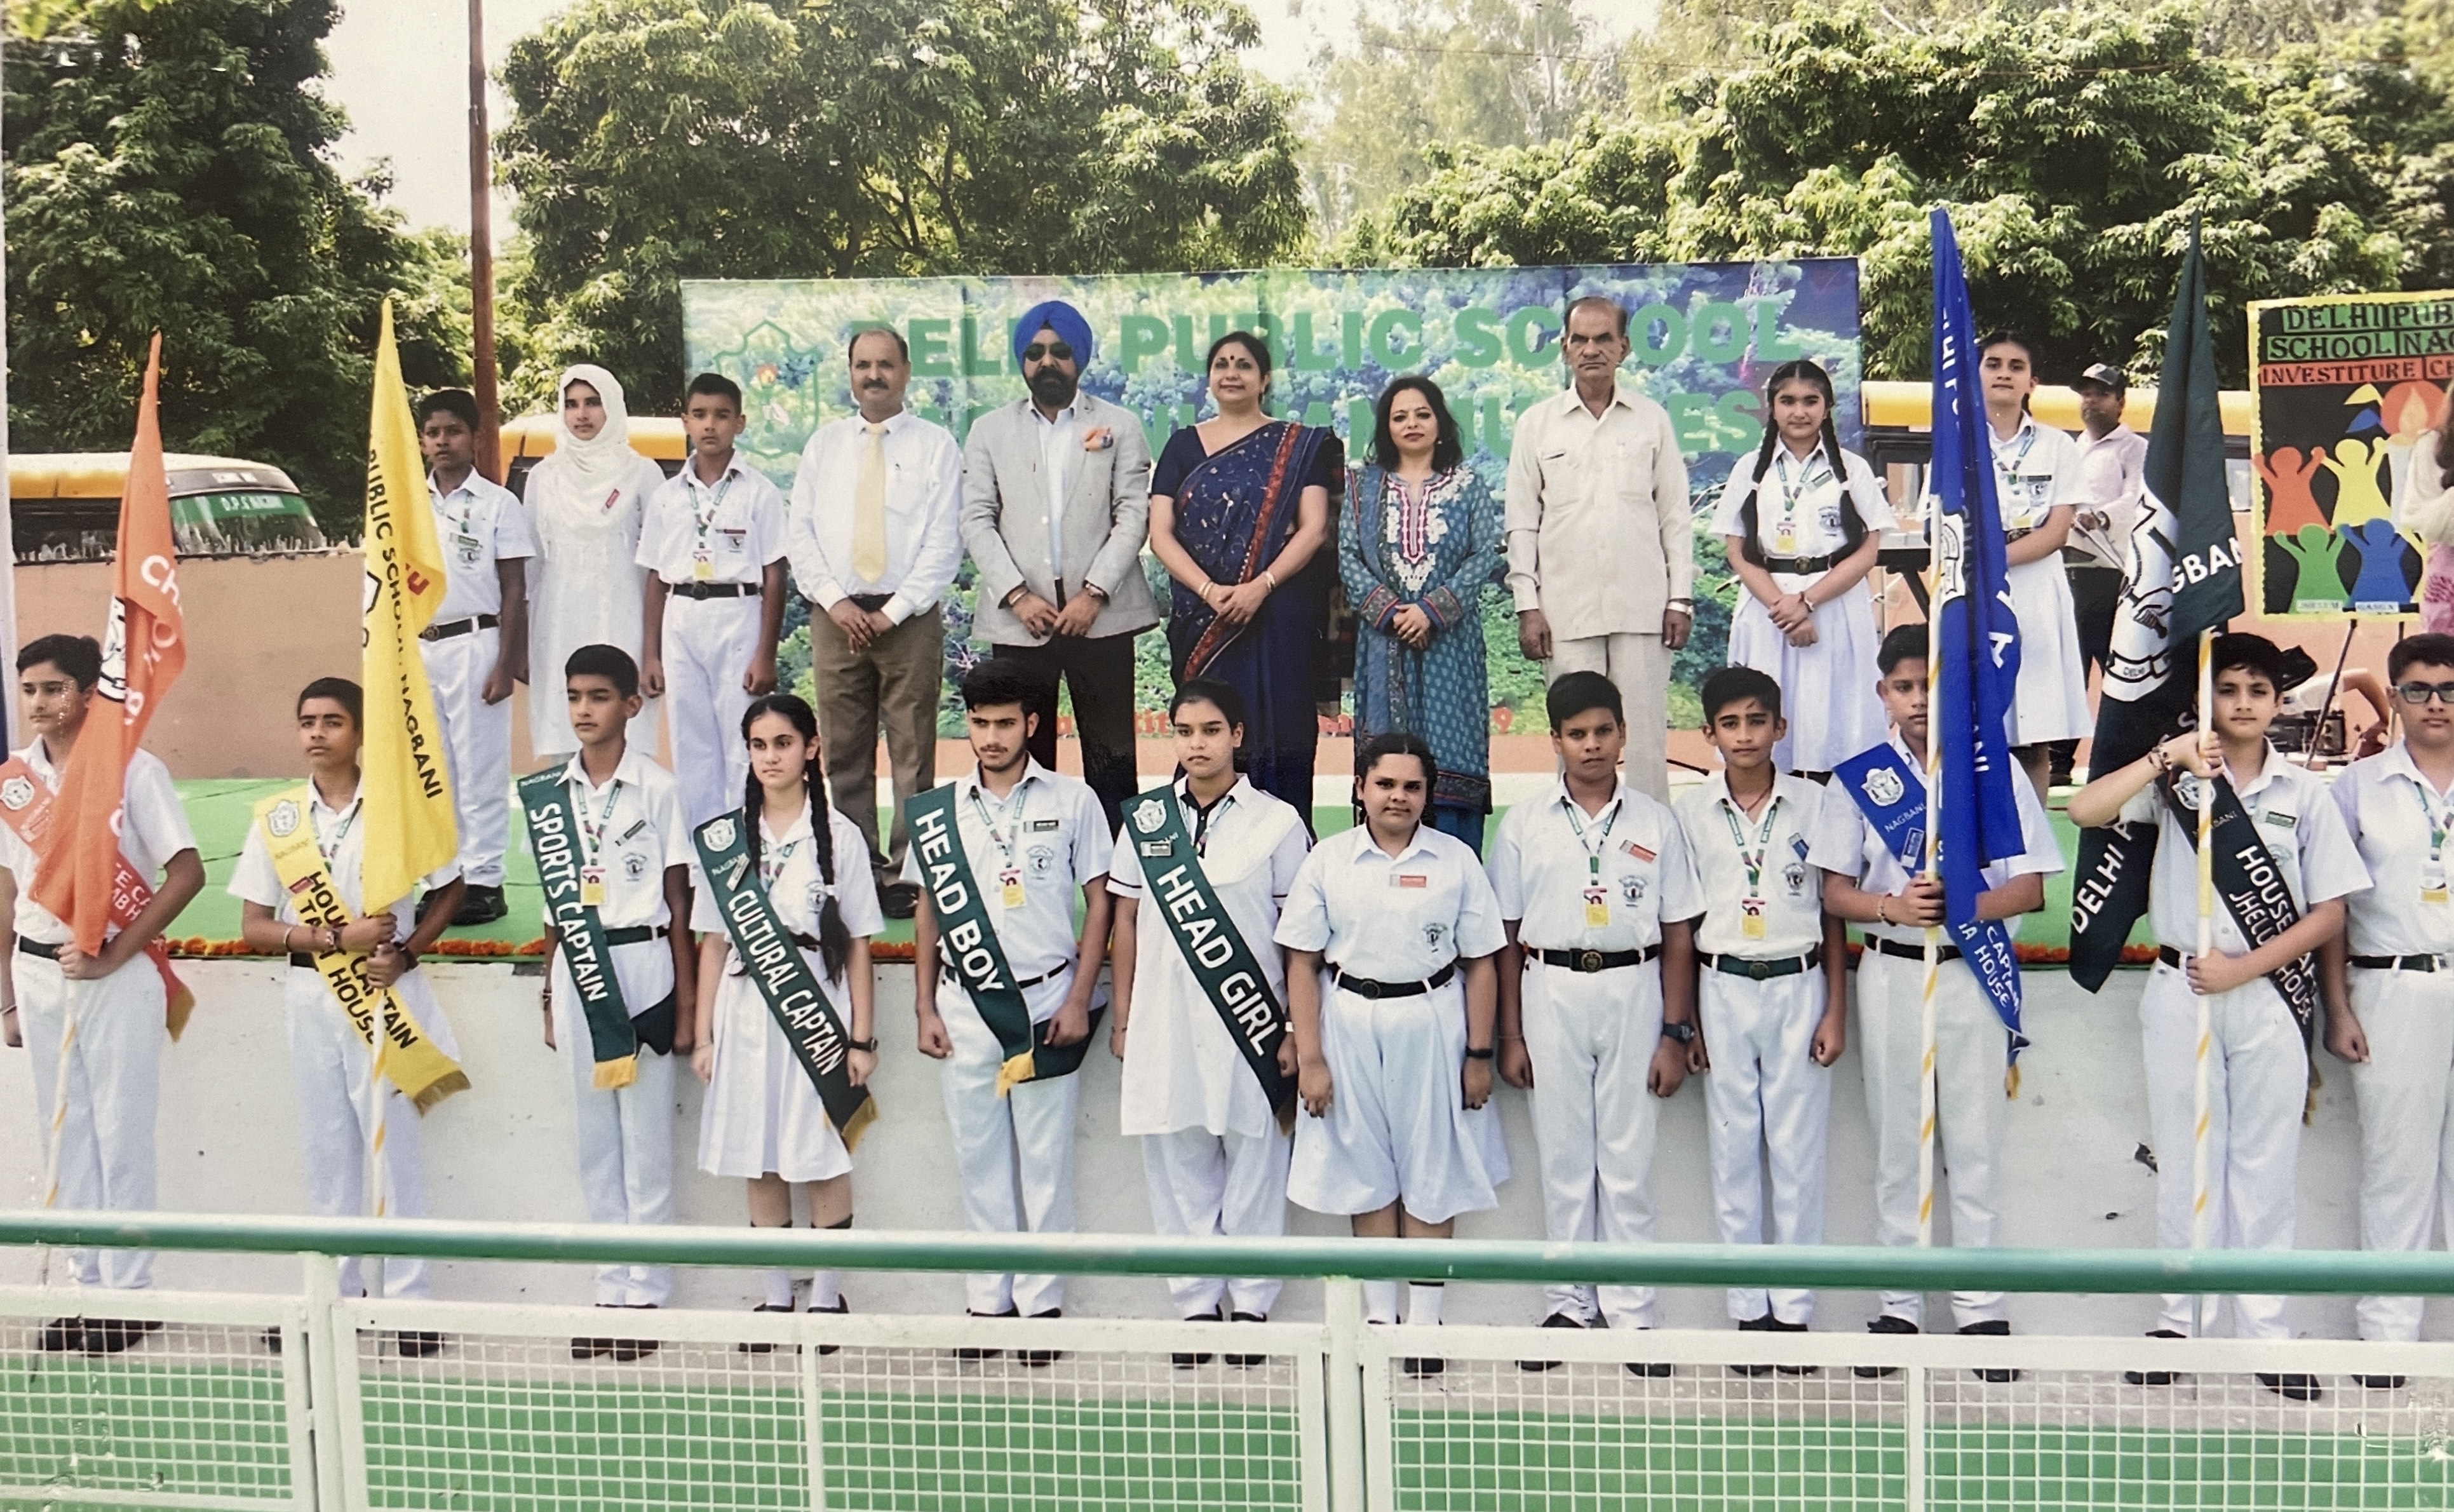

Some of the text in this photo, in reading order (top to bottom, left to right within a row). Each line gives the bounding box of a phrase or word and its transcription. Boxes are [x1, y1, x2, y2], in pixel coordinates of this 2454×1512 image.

[1453, 300, 1804, 369] SCOOL
[2269, 332, 2392, 360] SCHOOL
[2286, 304, 2382, 330] DELHI
[2262, 360, 2416, 384] INVESTITURE
[530, 802, 608, 1002] SPORTS CAPTAIN
[915, 807, 1005, 993] HEAD BOY
[2070, 842, 2125, 935] DELHI
[2228, 890, 2277, 947] JHELU
[727, 889, 846, 1076] CULTURAL CAPTAIN
[1156, 863, 1278, 1057] HEAD GIRL
[1974, 945, 2011, 1008] HOUSE
